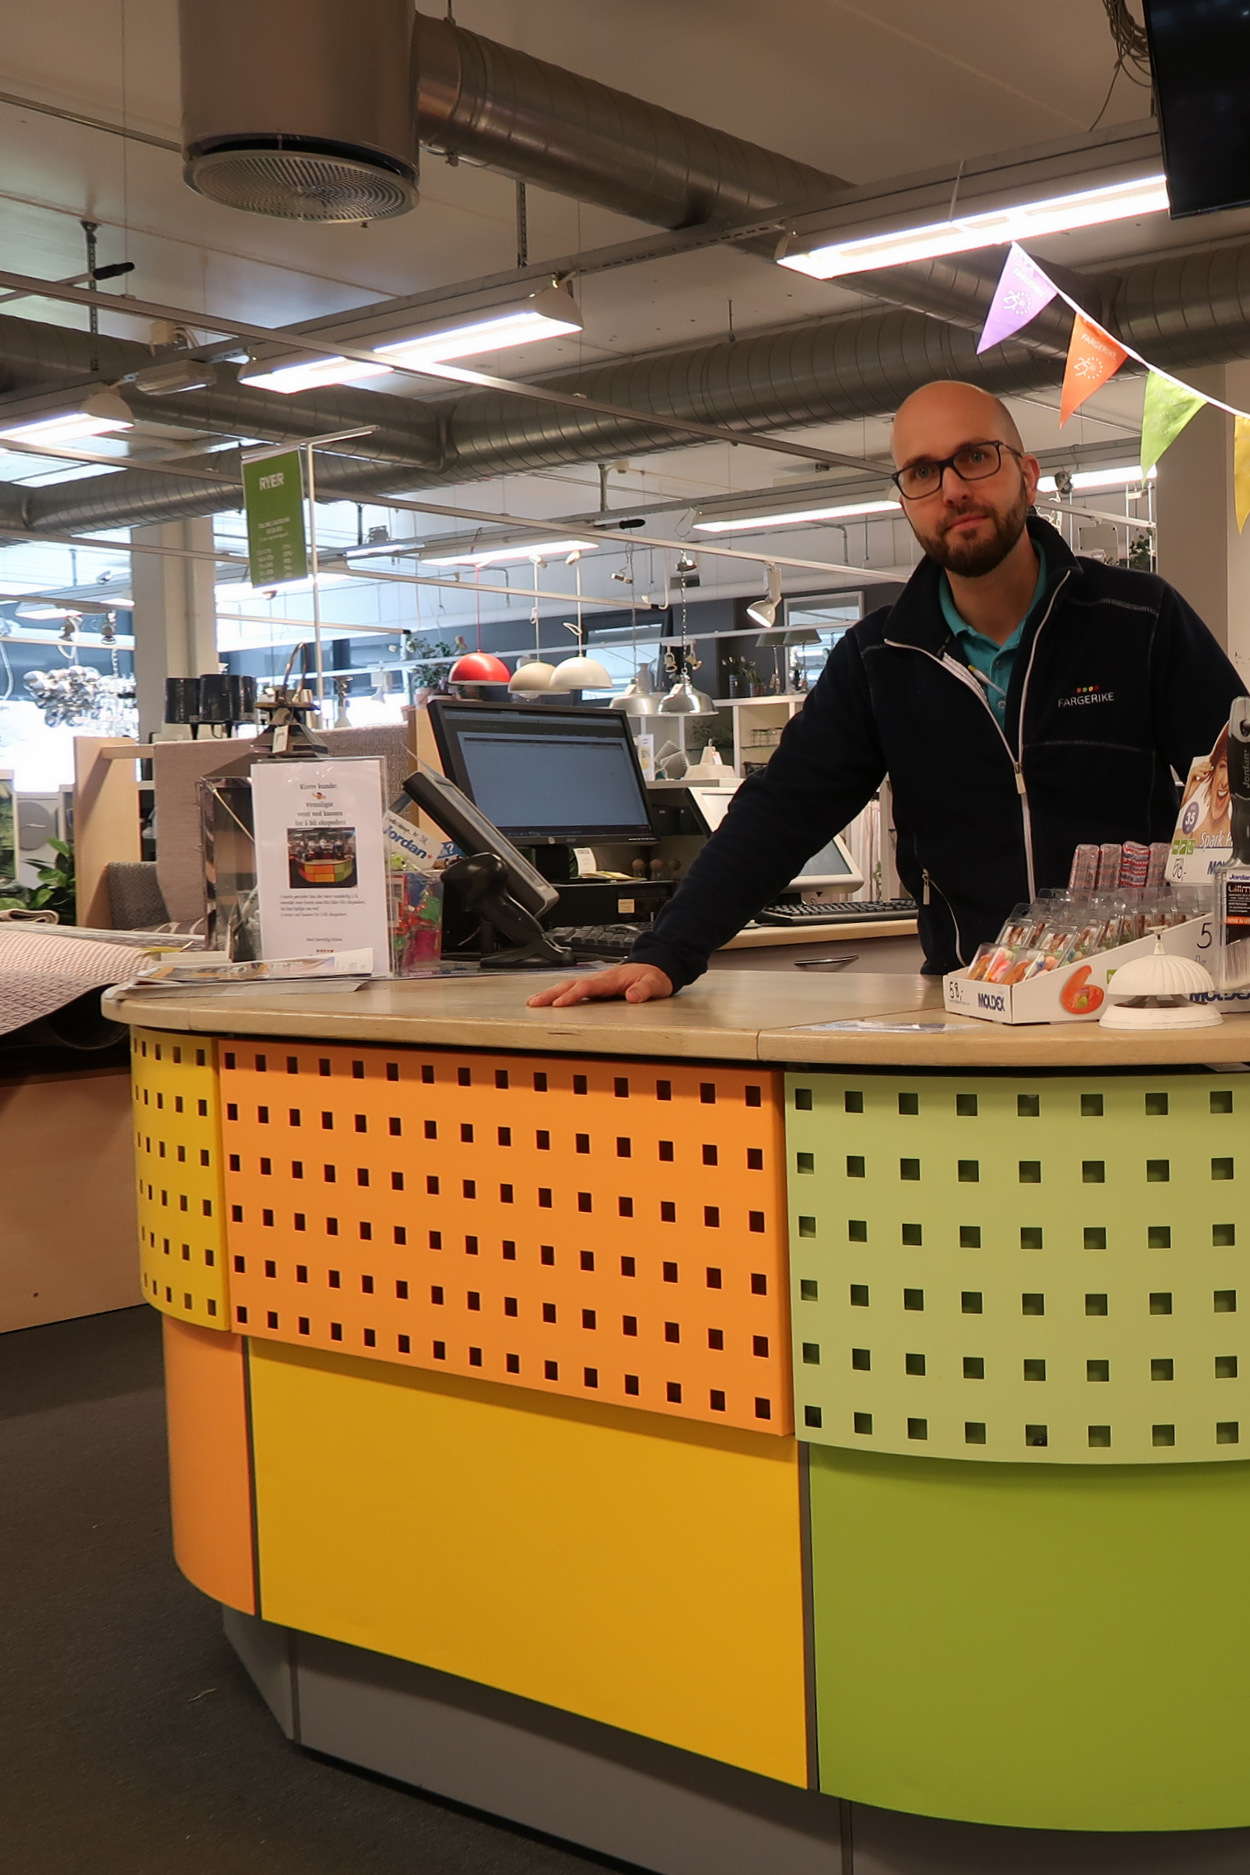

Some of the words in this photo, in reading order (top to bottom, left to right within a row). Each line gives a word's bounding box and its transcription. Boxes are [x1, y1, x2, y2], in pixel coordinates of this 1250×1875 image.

[1002, 290, 1019, 310] 25
[1081, 333, 1118, 361] FARGERIKE
[1074, 357, 1091, 377] 25
[1057, 692, 1115, 708] FARGERIKE
[1185, 812, 1197, 825] 35
[382, 824, 427, 859] Jordan
[1200, 831, 1224, 853] Spark
[978, 993, 1006, 1012] MOLDEX
